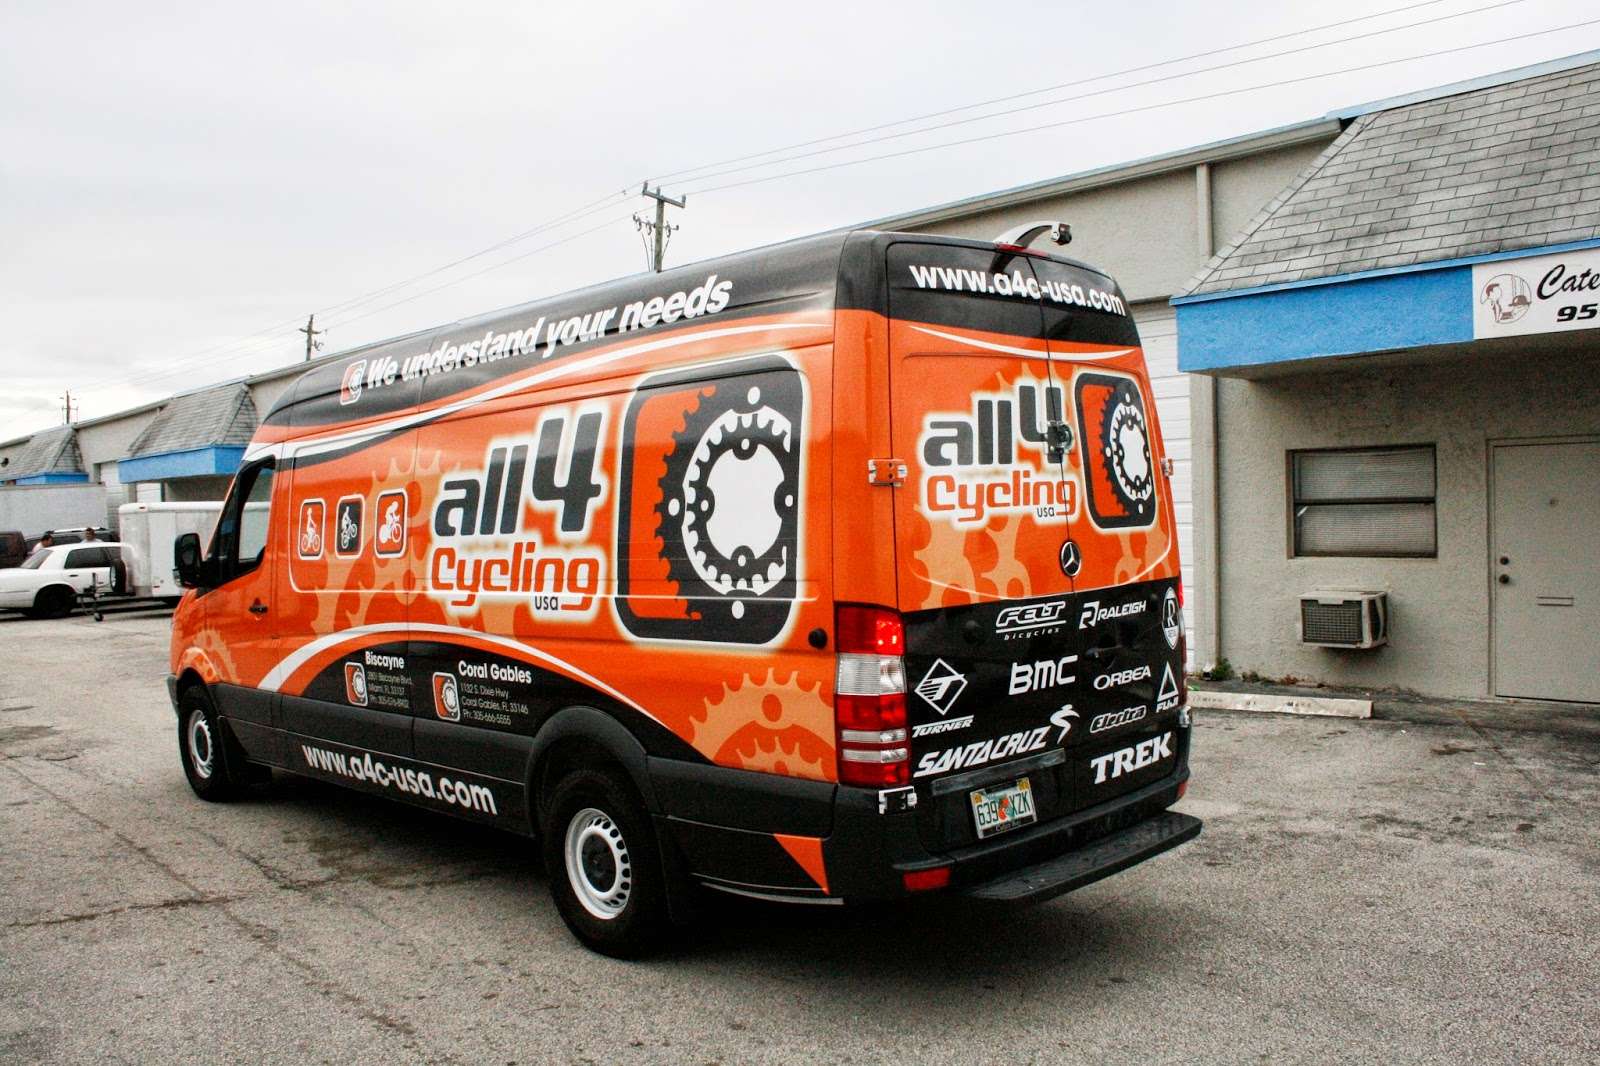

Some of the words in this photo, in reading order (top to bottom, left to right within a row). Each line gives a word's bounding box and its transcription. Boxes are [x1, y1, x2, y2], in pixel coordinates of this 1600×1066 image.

[909, 265, 1126, 317] www.a4c-usa.com
[366, 359, 397, 389] We
[402, 318, 542, 382] understand
[543, 306, 617, 358] your
[618, 274, 733, 333] needs
[926, 470, 1076, 523] Cycling
[1036, 507, 1055, 518] usa
[431, 542, 600, 611] Cycling
[535, 595, 558, 611] usa
[1097, 600, 1147, 621] RALEIGH
[365, 651, 405, 670] Biscayne
[458, 660, 488, 679] Coral
[490, 663, 532, 684] Gables
[1008, 655, 1079, 696] BMC
[1093, 665, 1151, 691] ORBEA
[912, 714, 974, 738] TURNER
[1091, 731, 1172, 785] TREK
[301, 745, 498, 815] www.a4c-usa.com
